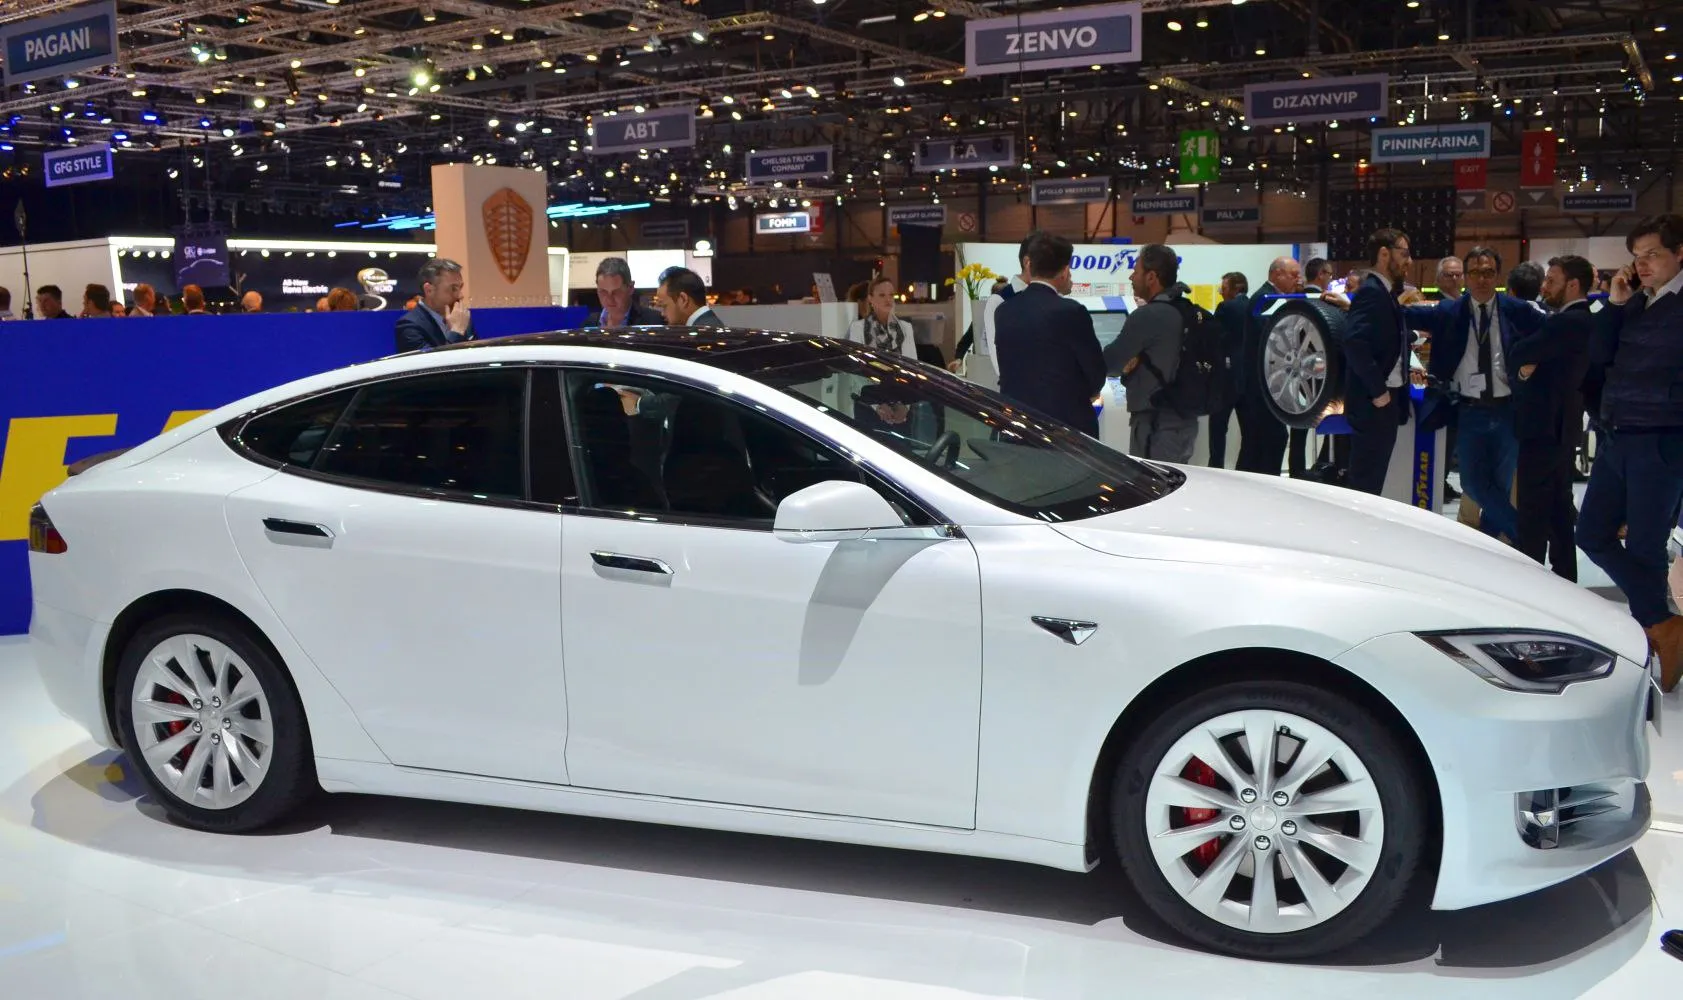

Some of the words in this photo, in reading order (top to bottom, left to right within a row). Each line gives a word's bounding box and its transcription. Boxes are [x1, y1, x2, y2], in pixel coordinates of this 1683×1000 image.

[24, 26, 91, 62] PAGANI
[1005, 26, 1098, 55] ZENVO
[1272, 91, 1358, 109] DIZAYNVIP
[623, 121, 660, 140] ABT
[1382, 135, 1480, 151] PININFARINA
[54, 160, 73, 174] GFG
[74, 156, 102, 171] STYLE
[792, 155, 816, 163] TRUCK
[772, 164, 805, 172] COMPANY
[1136, 199, 1191, 210] HENNESSEY
[1216, 210, 1245, 219] PAL-V
